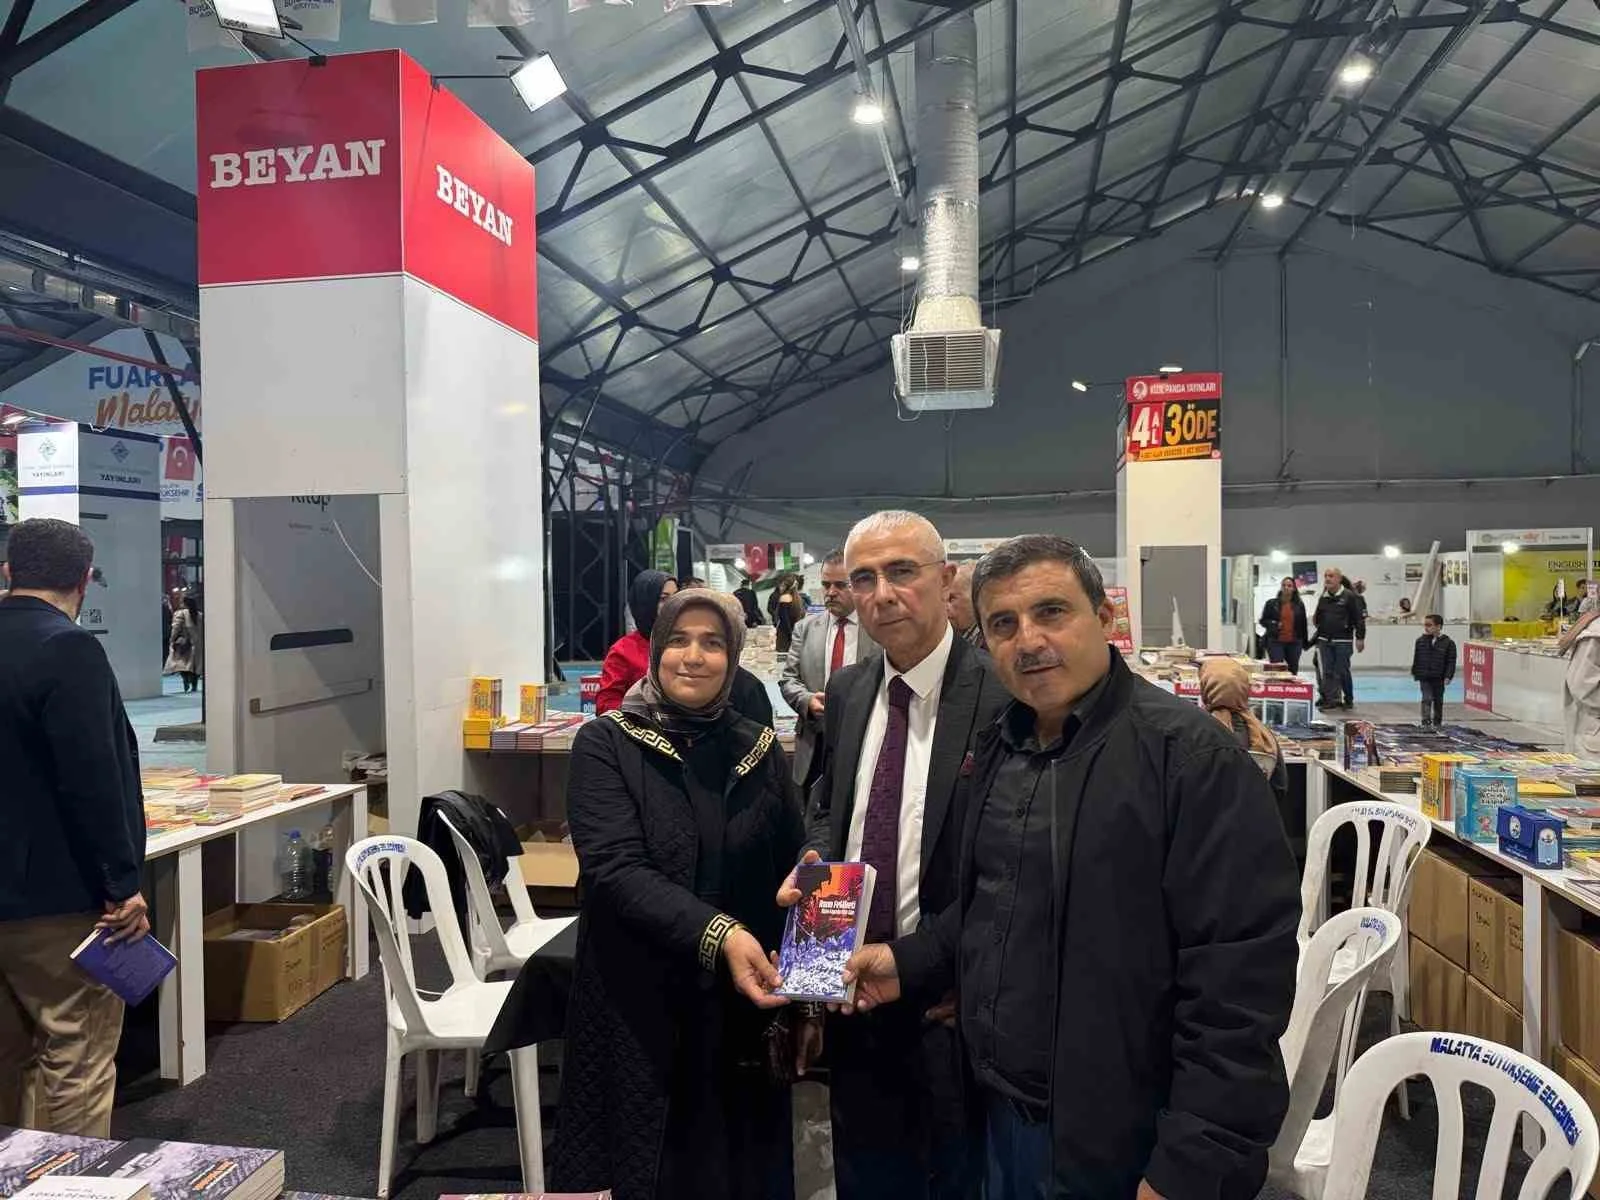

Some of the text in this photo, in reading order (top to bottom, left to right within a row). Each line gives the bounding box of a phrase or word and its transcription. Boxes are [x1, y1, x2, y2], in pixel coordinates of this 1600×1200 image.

[210, 139, 385, 189] BEYAN
[436, 164, 513, 247] BEYAN
[1132, 406, 1150, 448] 4
[1430, 1037, 1482, 1062] MALATYA
